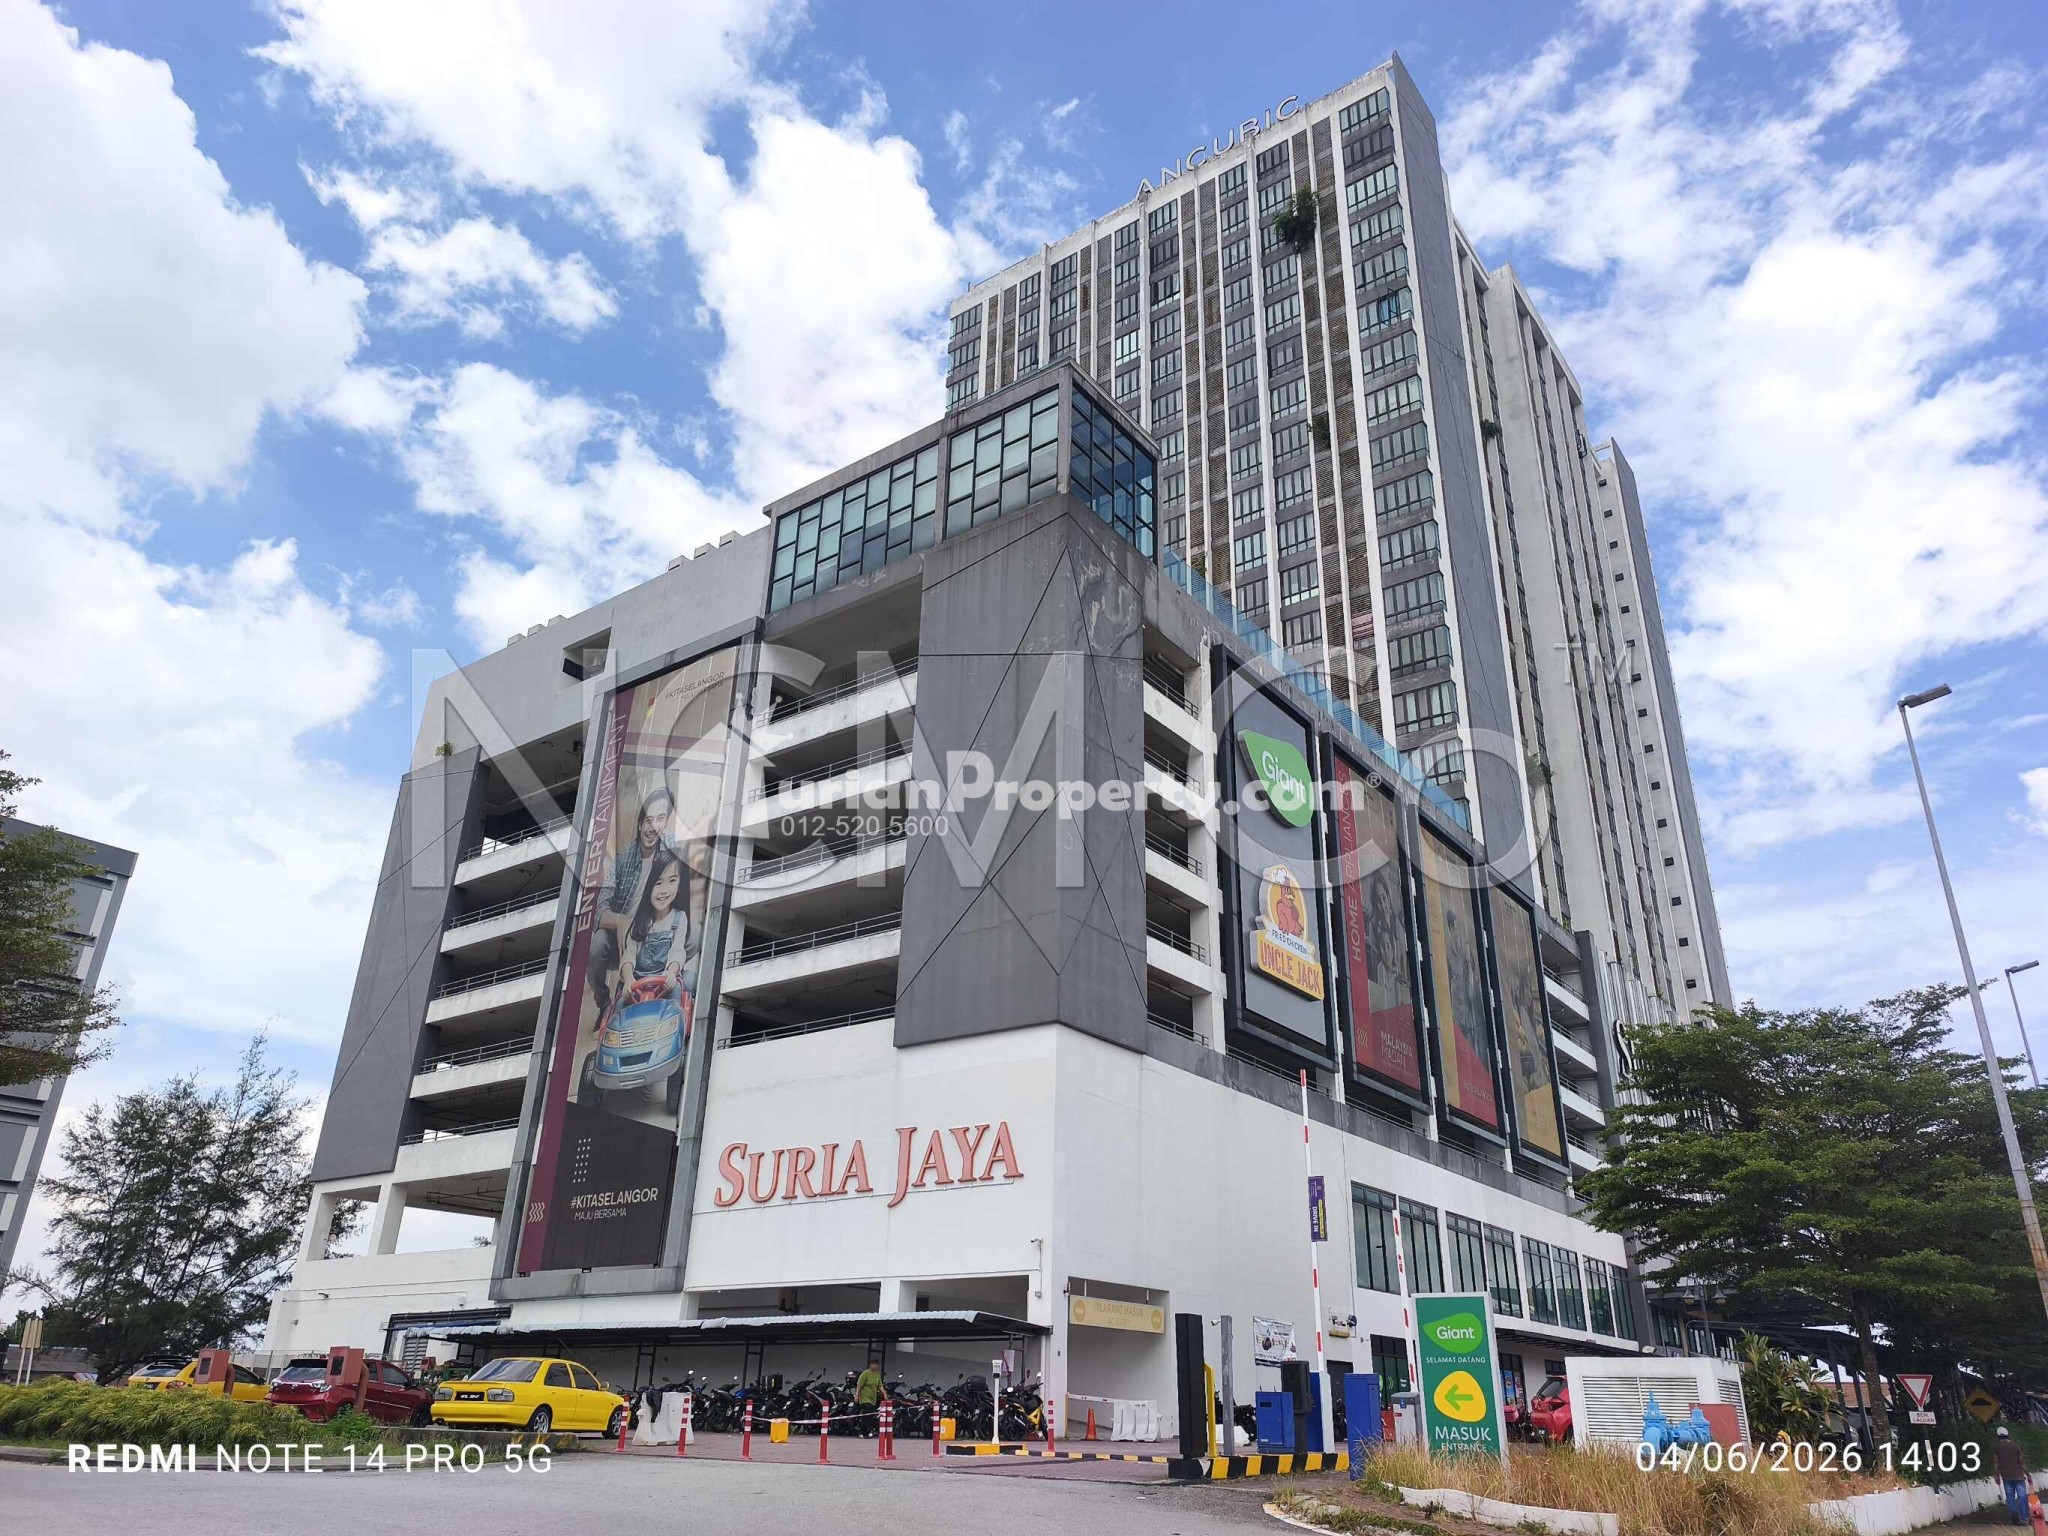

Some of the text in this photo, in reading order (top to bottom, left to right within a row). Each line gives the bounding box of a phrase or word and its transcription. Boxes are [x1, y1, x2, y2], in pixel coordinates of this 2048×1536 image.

[1261, 750, 1307, 805] Giant
[577, 713, 627, 933] ENTERTAINMENT
[1346, 894, 1362, 963] HOME
[1272, 929, 1308, 955] FRIED CHICKEN
[1260, 940, 1322, 994] UNCLE JACK
[714, 1121, 1024, 1208] SURIA JAYA
[570, 1187, 659, 1209] #KITASELANGOR
[574, 1207, 627, 1221] MAJU BERSAMA
[1437, 1326, 1475, 1340] Giant
[1426, 1356, 1486, 1364] SELAMAT DATANG
[1435, 1426, 1492, 1441] MASUK
[1441, 1442, 1488, 1452] ENTRANCE
